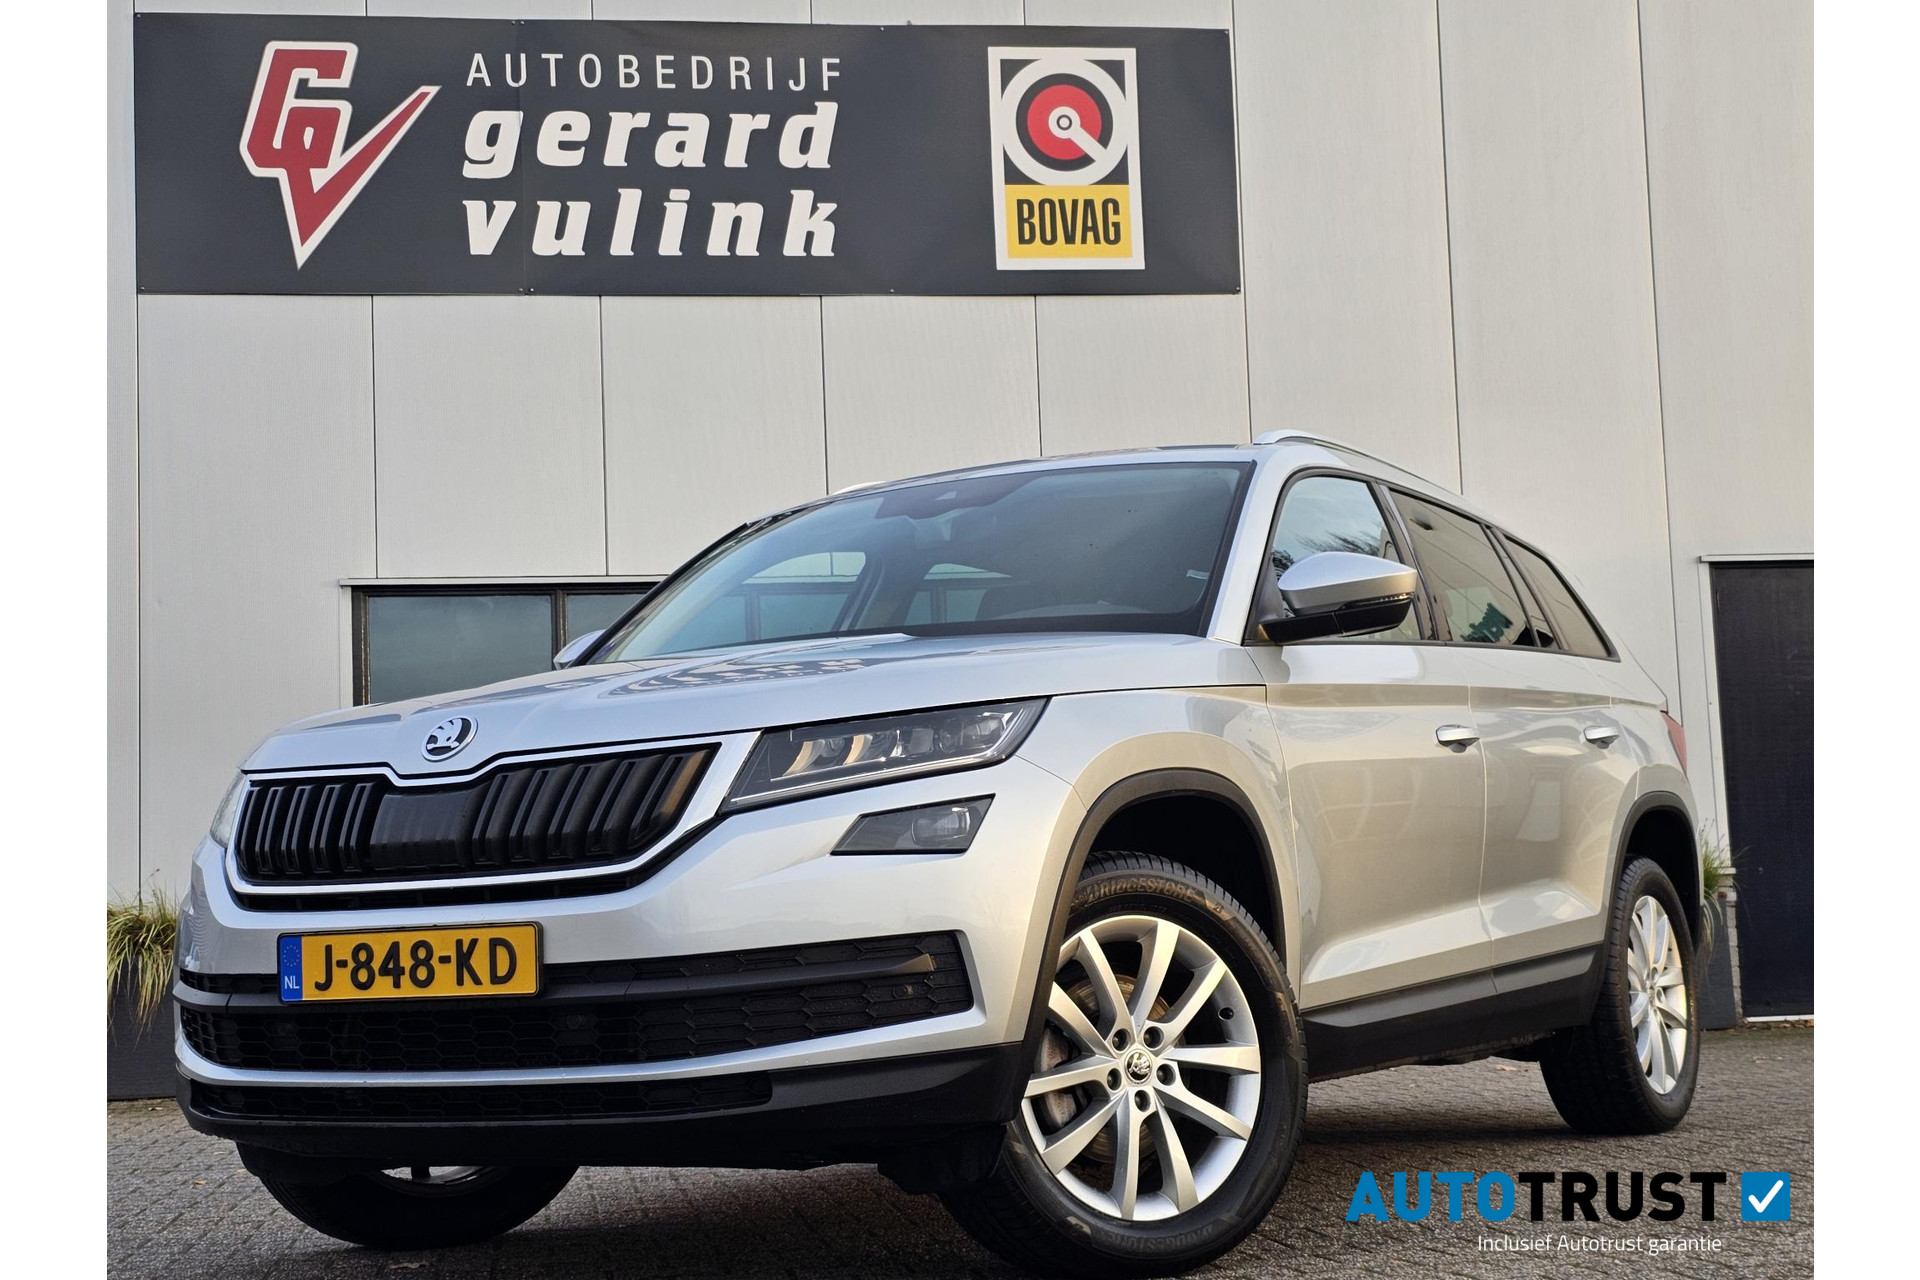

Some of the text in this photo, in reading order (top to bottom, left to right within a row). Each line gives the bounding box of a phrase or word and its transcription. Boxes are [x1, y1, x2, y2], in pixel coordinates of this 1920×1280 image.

[466, 53, 840, 91] AUTOBEDRIJF
[462, 102, 838, 179] gerard
[462, 188, 838, 257] vulink
[1016, 198, 1122, 245] BOVAG
[284, 975, 300, 989] NL
[314, 937, 517, 991] J-848-KD
